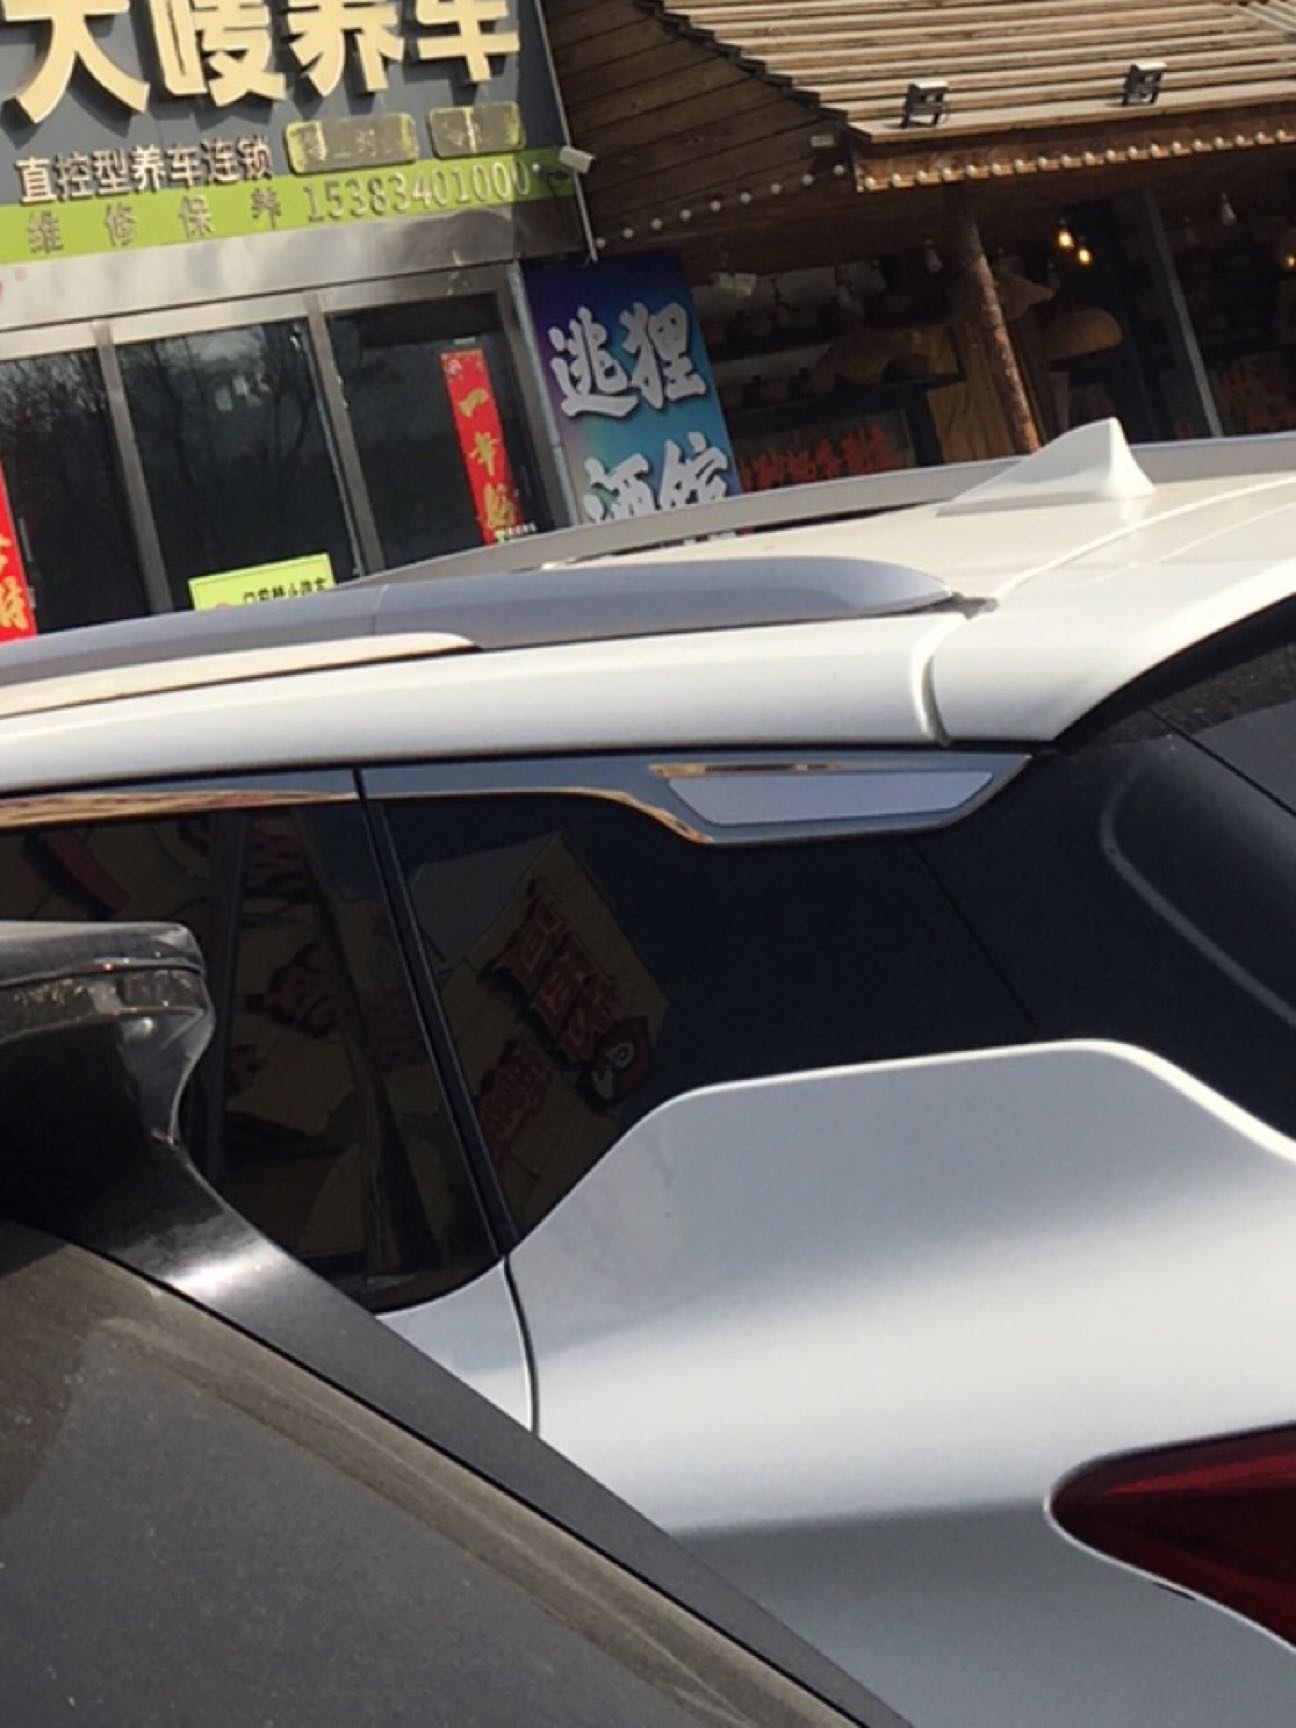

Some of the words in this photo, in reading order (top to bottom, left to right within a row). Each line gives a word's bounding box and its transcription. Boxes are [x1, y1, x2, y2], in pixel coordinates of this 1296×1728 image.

[16, 134, 273, 206] 直控型养车连锁
[28, 186, 281, 254] 维修保养
[304, 160, 531, 222] 15383401000
[548, 302, 706, 417] 逃狸
